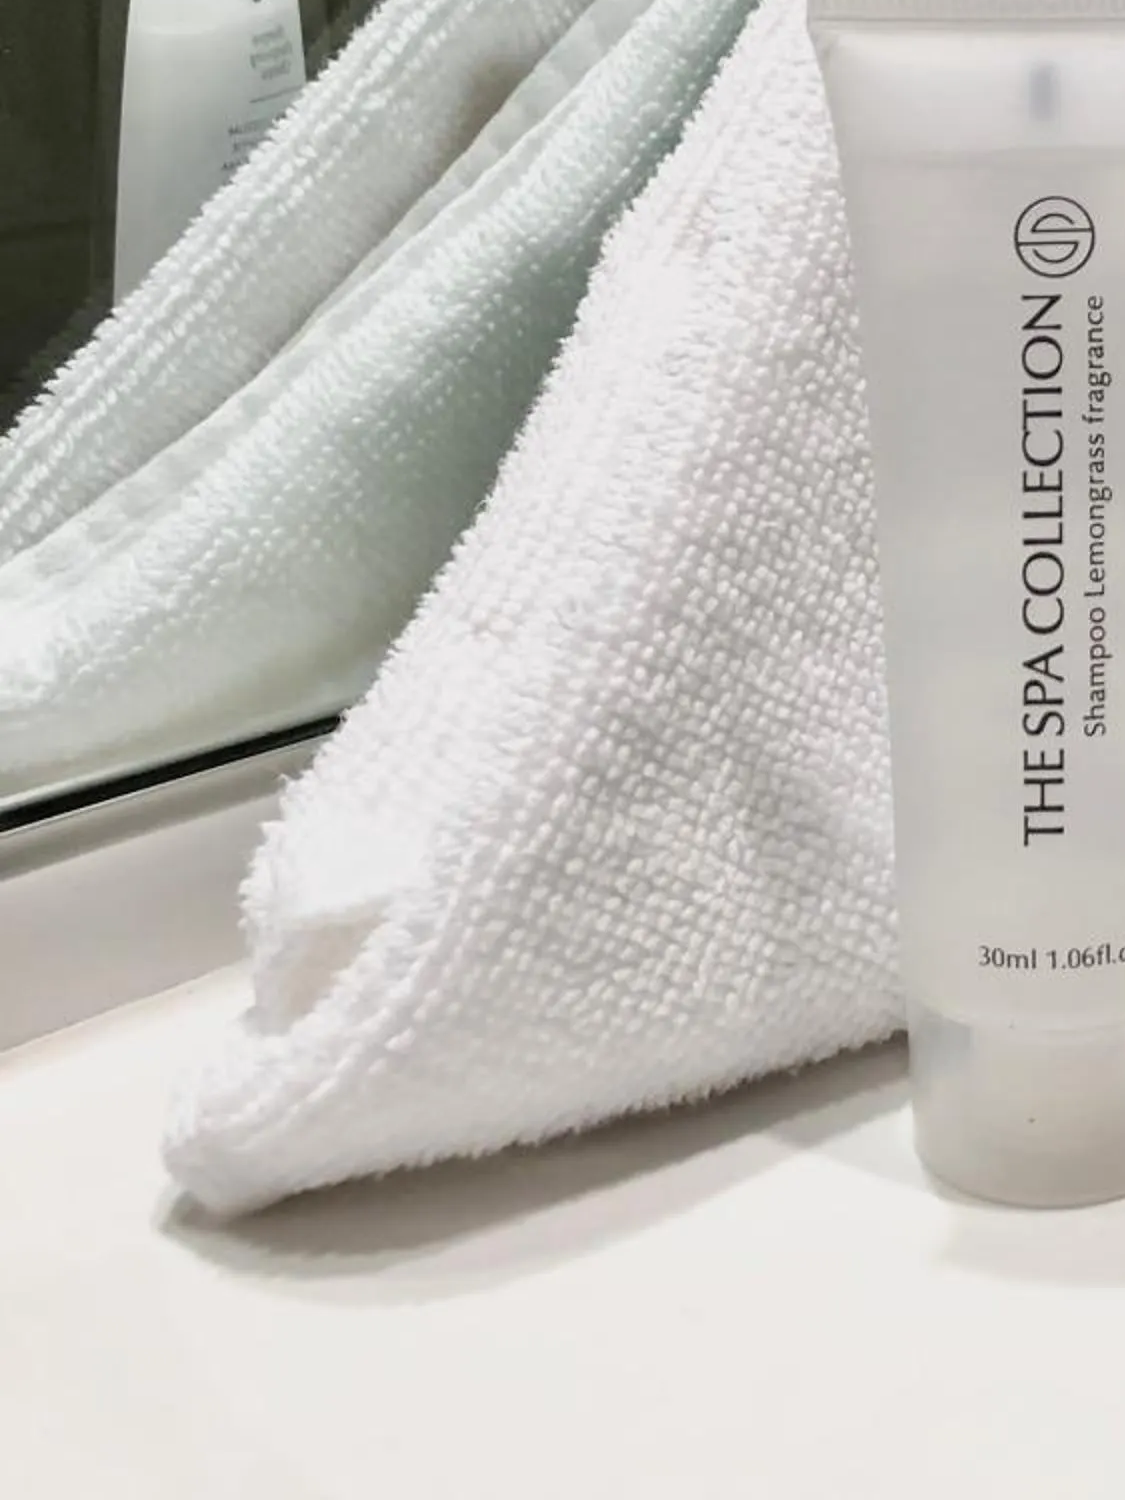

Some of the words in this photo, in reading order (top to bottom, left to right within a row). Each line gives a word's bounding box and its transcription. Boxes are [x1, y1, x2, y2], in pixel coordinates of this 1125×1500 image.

[1082, 295, 1112, 424] fragrance
[1021, 294, 1064, 635] COLLECTION
[1084, 433, 1113, 597] Lemongrass
[1022, 645, 1065, 737] SPA
[1083, 607, 1113, 737] Shampoo
[1023, 748, 1065, 847] THE
[978, 944, 1037, 970] 30ml
